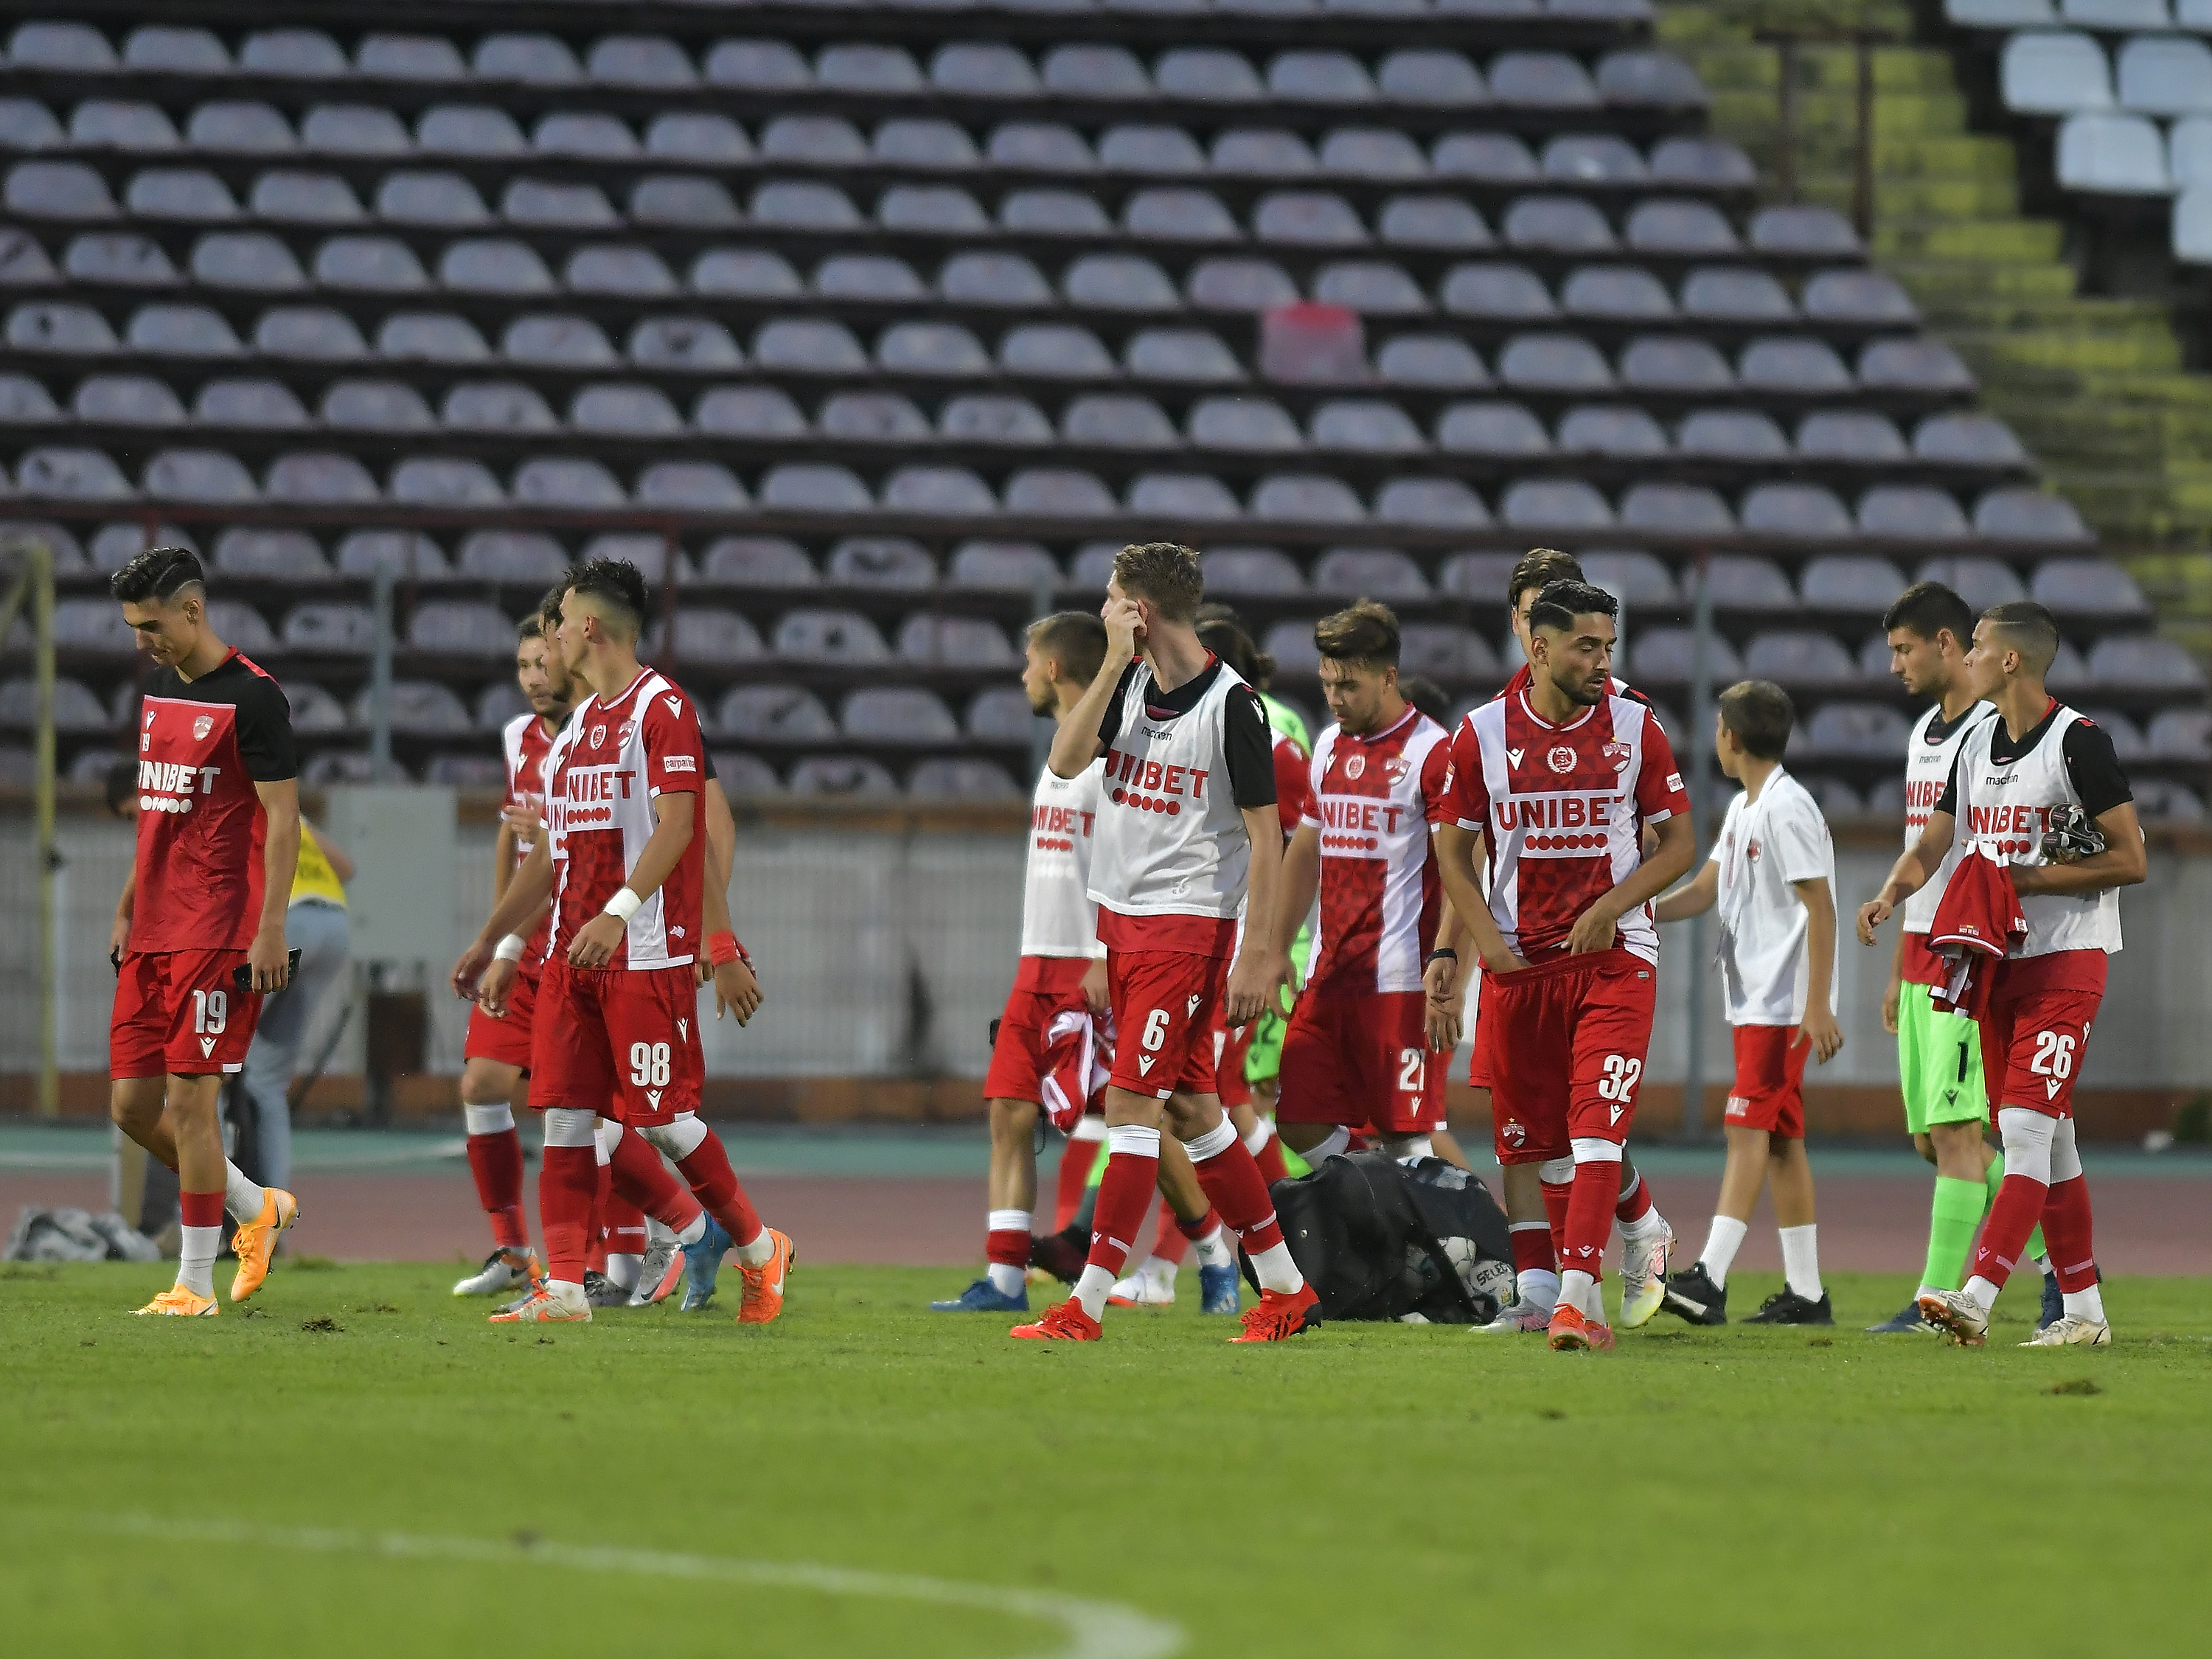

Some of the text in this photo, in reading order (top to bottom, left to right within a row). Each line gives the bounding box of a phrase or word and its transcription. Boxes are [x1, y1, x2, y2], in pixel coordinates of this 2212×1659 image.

[1986, 774, 2018, 785] macron
[193, 990, 227, 1034] 19
[1142, 1009, 1170, 1051] 6
[631, 1042, 670, 1086] 98
[1399, 1048, 1425, 1091] 21
[1958, 1042, 1969, 1082] 1
[2031, 1030, 2076, 1079] 26
[1599, 1054, 1642, 1103] 32
